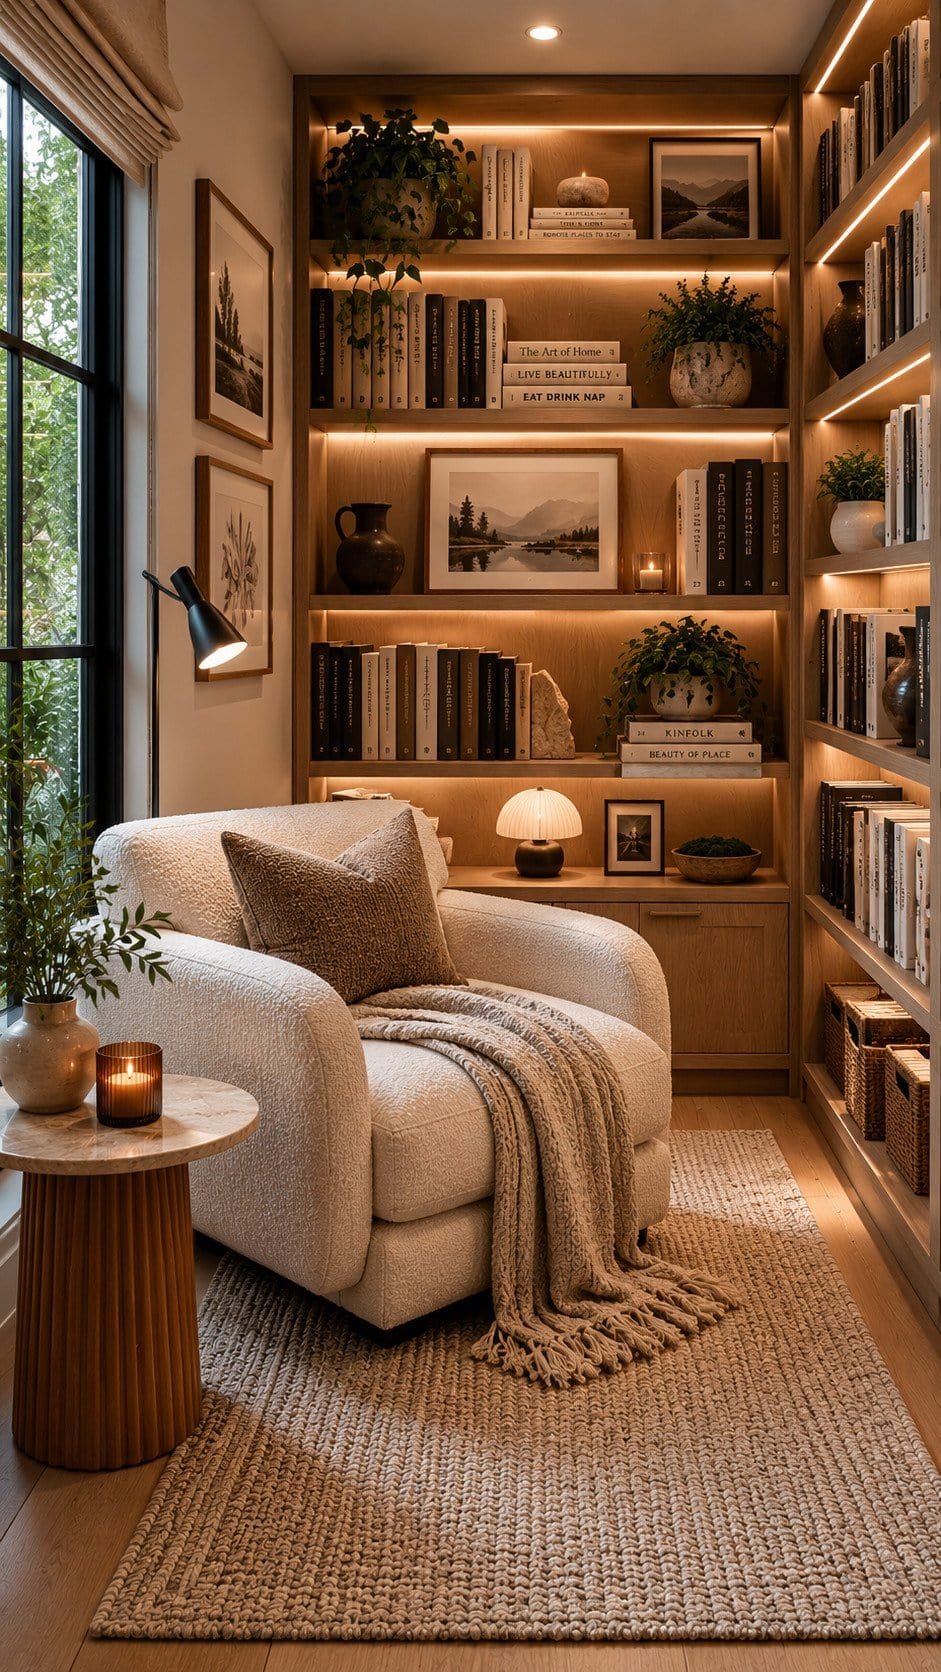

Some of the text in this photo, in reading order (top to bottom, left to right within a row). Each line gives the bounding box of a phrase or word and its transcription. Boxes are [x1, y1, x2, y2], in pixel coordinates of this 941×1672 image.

[519, 347, 602, 357] The Art of Home
[517, 370, 612, 379] LIVE BEAUTIFULLY
[523, 393, 606, 402] EAT DRINK NAP
[665, 729, 714, 738] KINFOLK
[649, 750, 731, 759] BEAUTY OF PLACE
